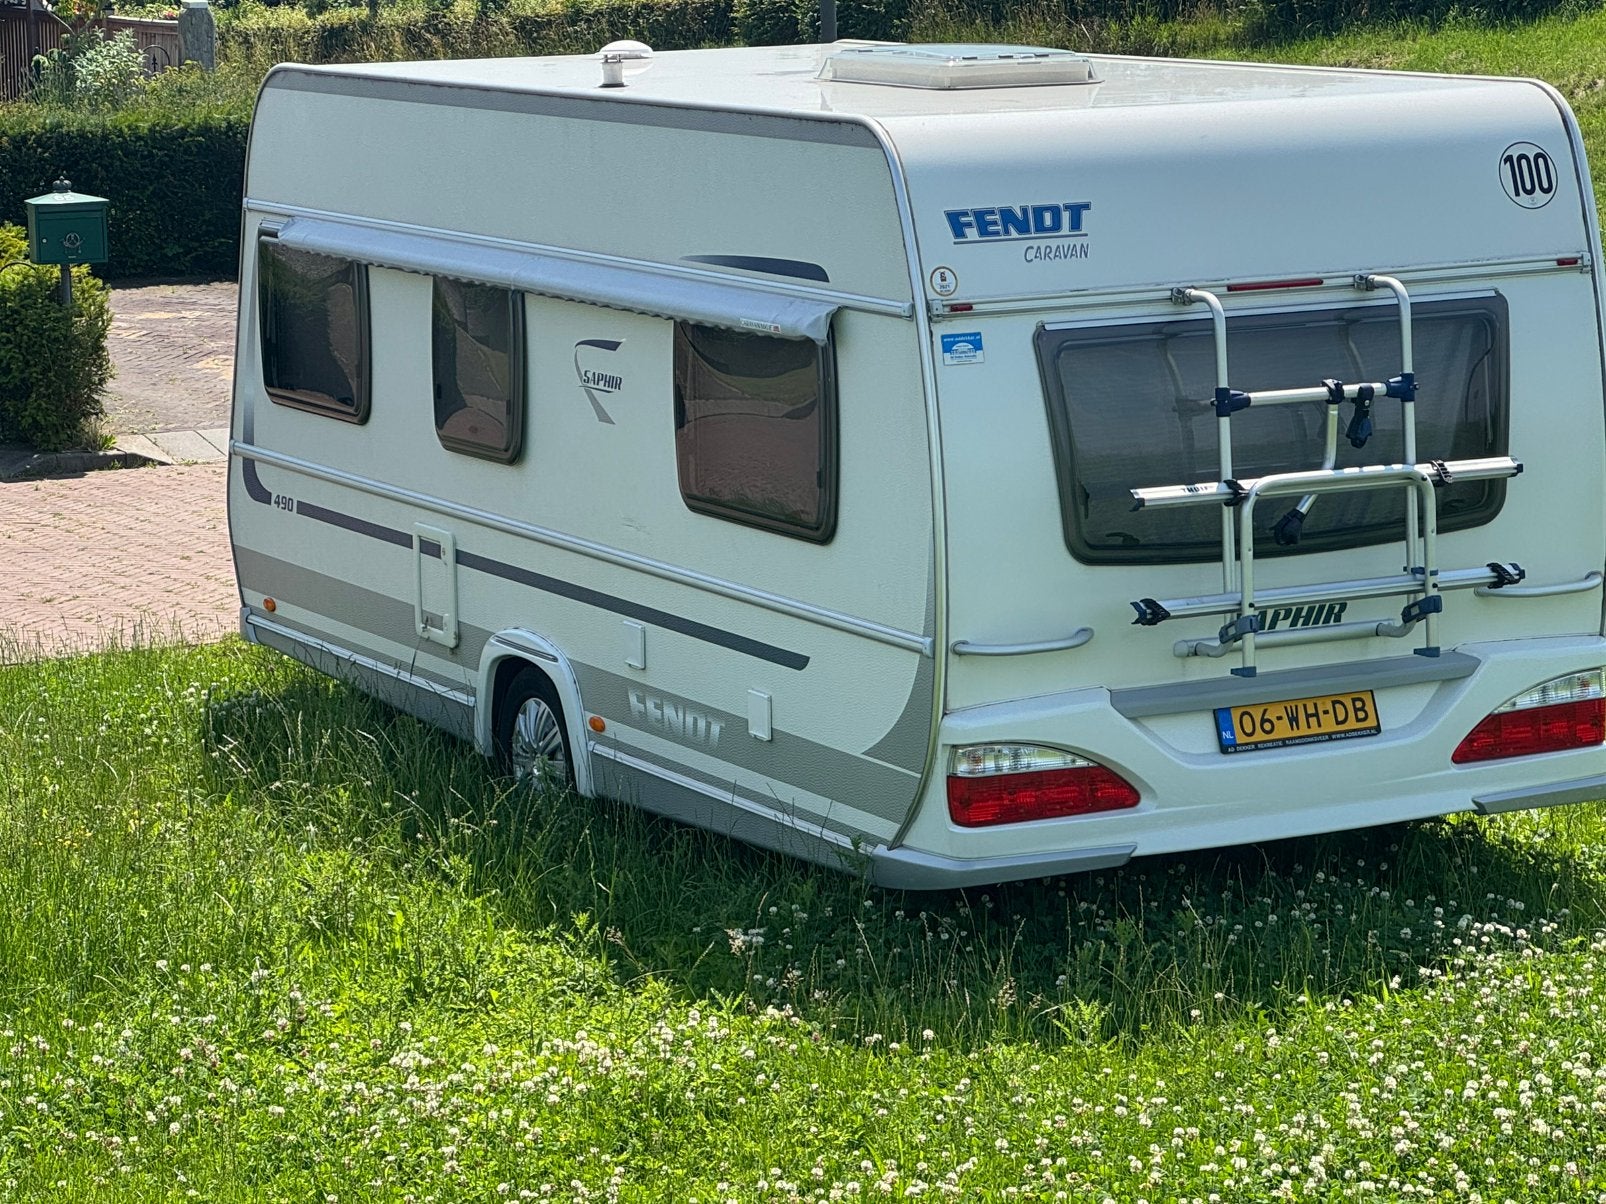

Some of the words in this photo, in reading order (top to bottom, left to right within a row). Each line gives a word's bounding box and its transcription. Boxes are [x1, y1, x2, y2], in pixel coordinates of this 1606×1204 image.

[1503, 152, 1553, 197] 100
[943, 201, 1092, 240] FENDT
[1024, 243, 1090, 263] CARAVAN
[583, 369, 623, 391] SAPHIR
[273, 494, 294, 512] 490
[1258, 601, 1348, 631] APHIR
[628, 687, 726, 747] FENDT
[1239, 696, 1370, 738] 06-WH-DB
[1222, 730, 1234, 740] NL
